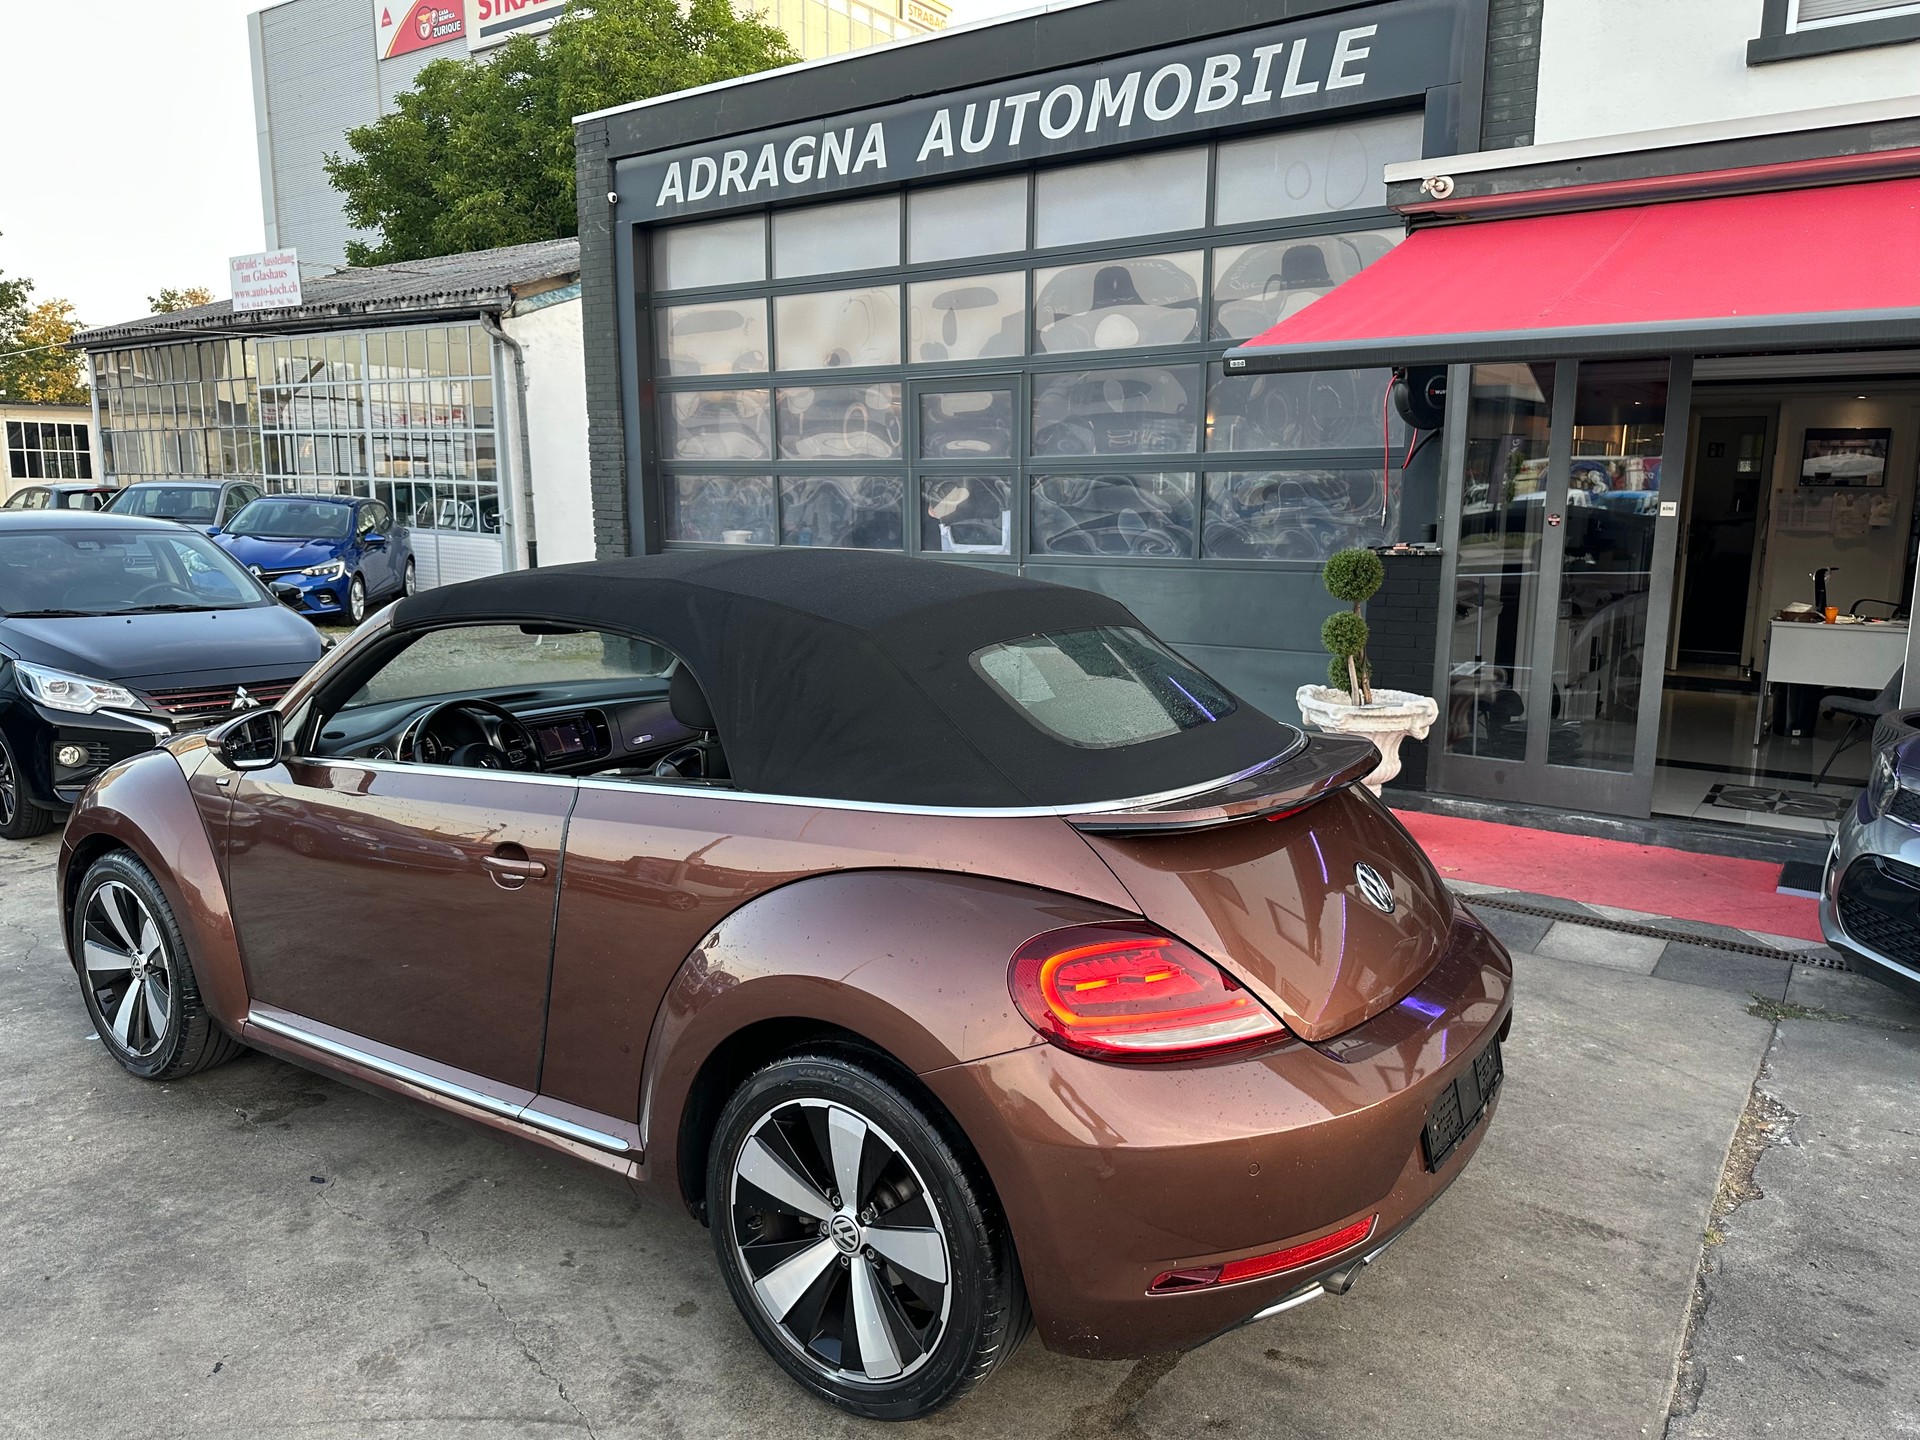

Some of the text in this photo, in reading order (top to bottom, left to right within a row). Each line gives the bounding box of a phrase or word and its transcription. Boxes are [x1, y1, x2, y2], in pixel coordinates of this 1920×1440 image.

[433, 21, 461, 37] ZURIQUE
[655, 24, 1378, 207] ADRAGNA AUTOMOBILE
[241, 268, 287, 283] im Glashaus
[234, 282, 298, 298] www.auto-koch.ch
